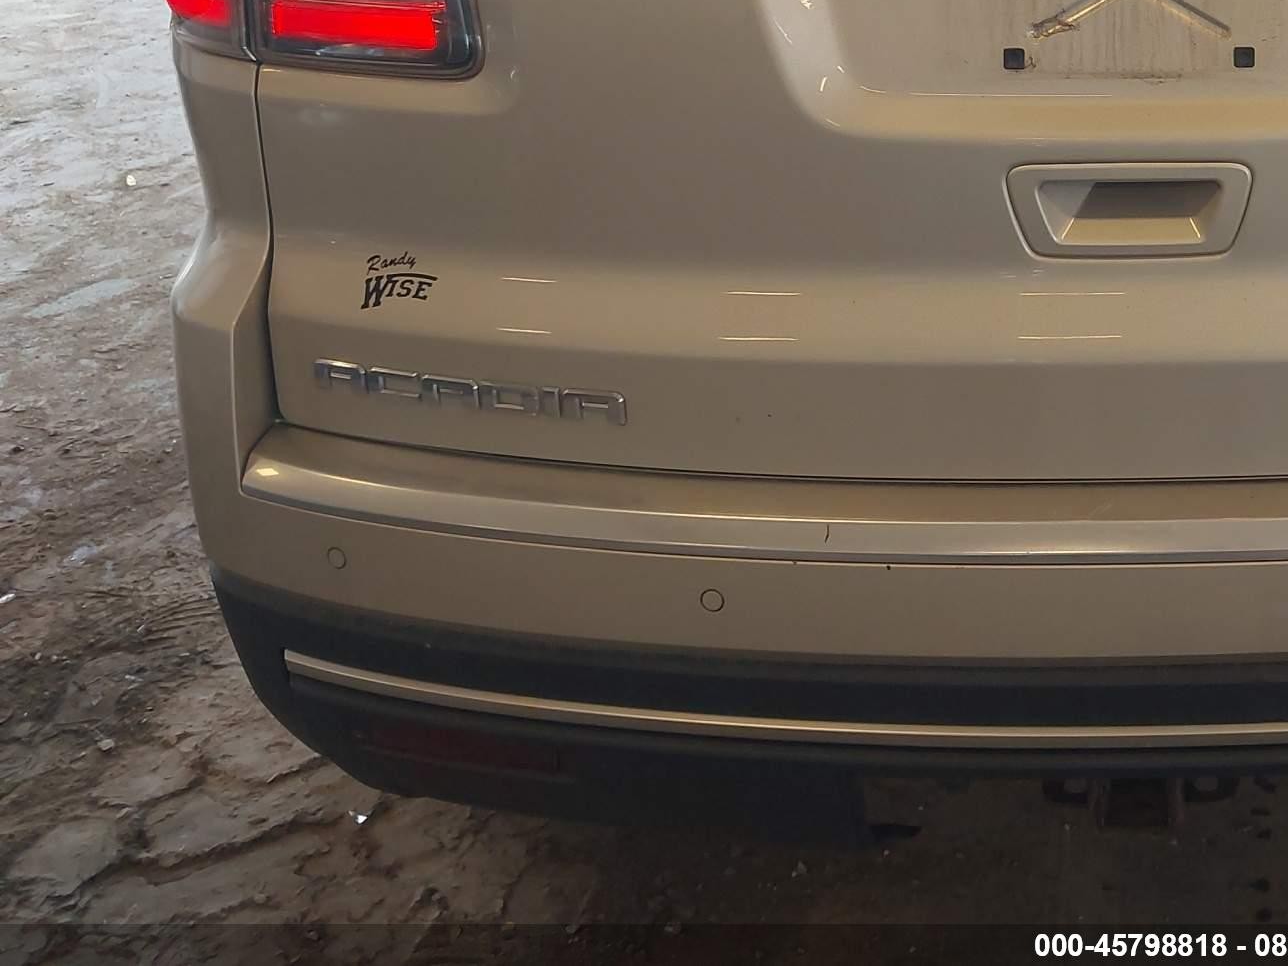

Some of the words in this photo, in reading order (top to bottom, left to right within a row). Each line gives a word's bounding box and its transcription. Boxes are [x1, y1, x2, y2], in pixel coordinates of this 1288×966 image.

[366, 250, 417, 276] Randy
[360, 273, 438, 310] WISE
[312, 357, 627, 426] ACADIA
